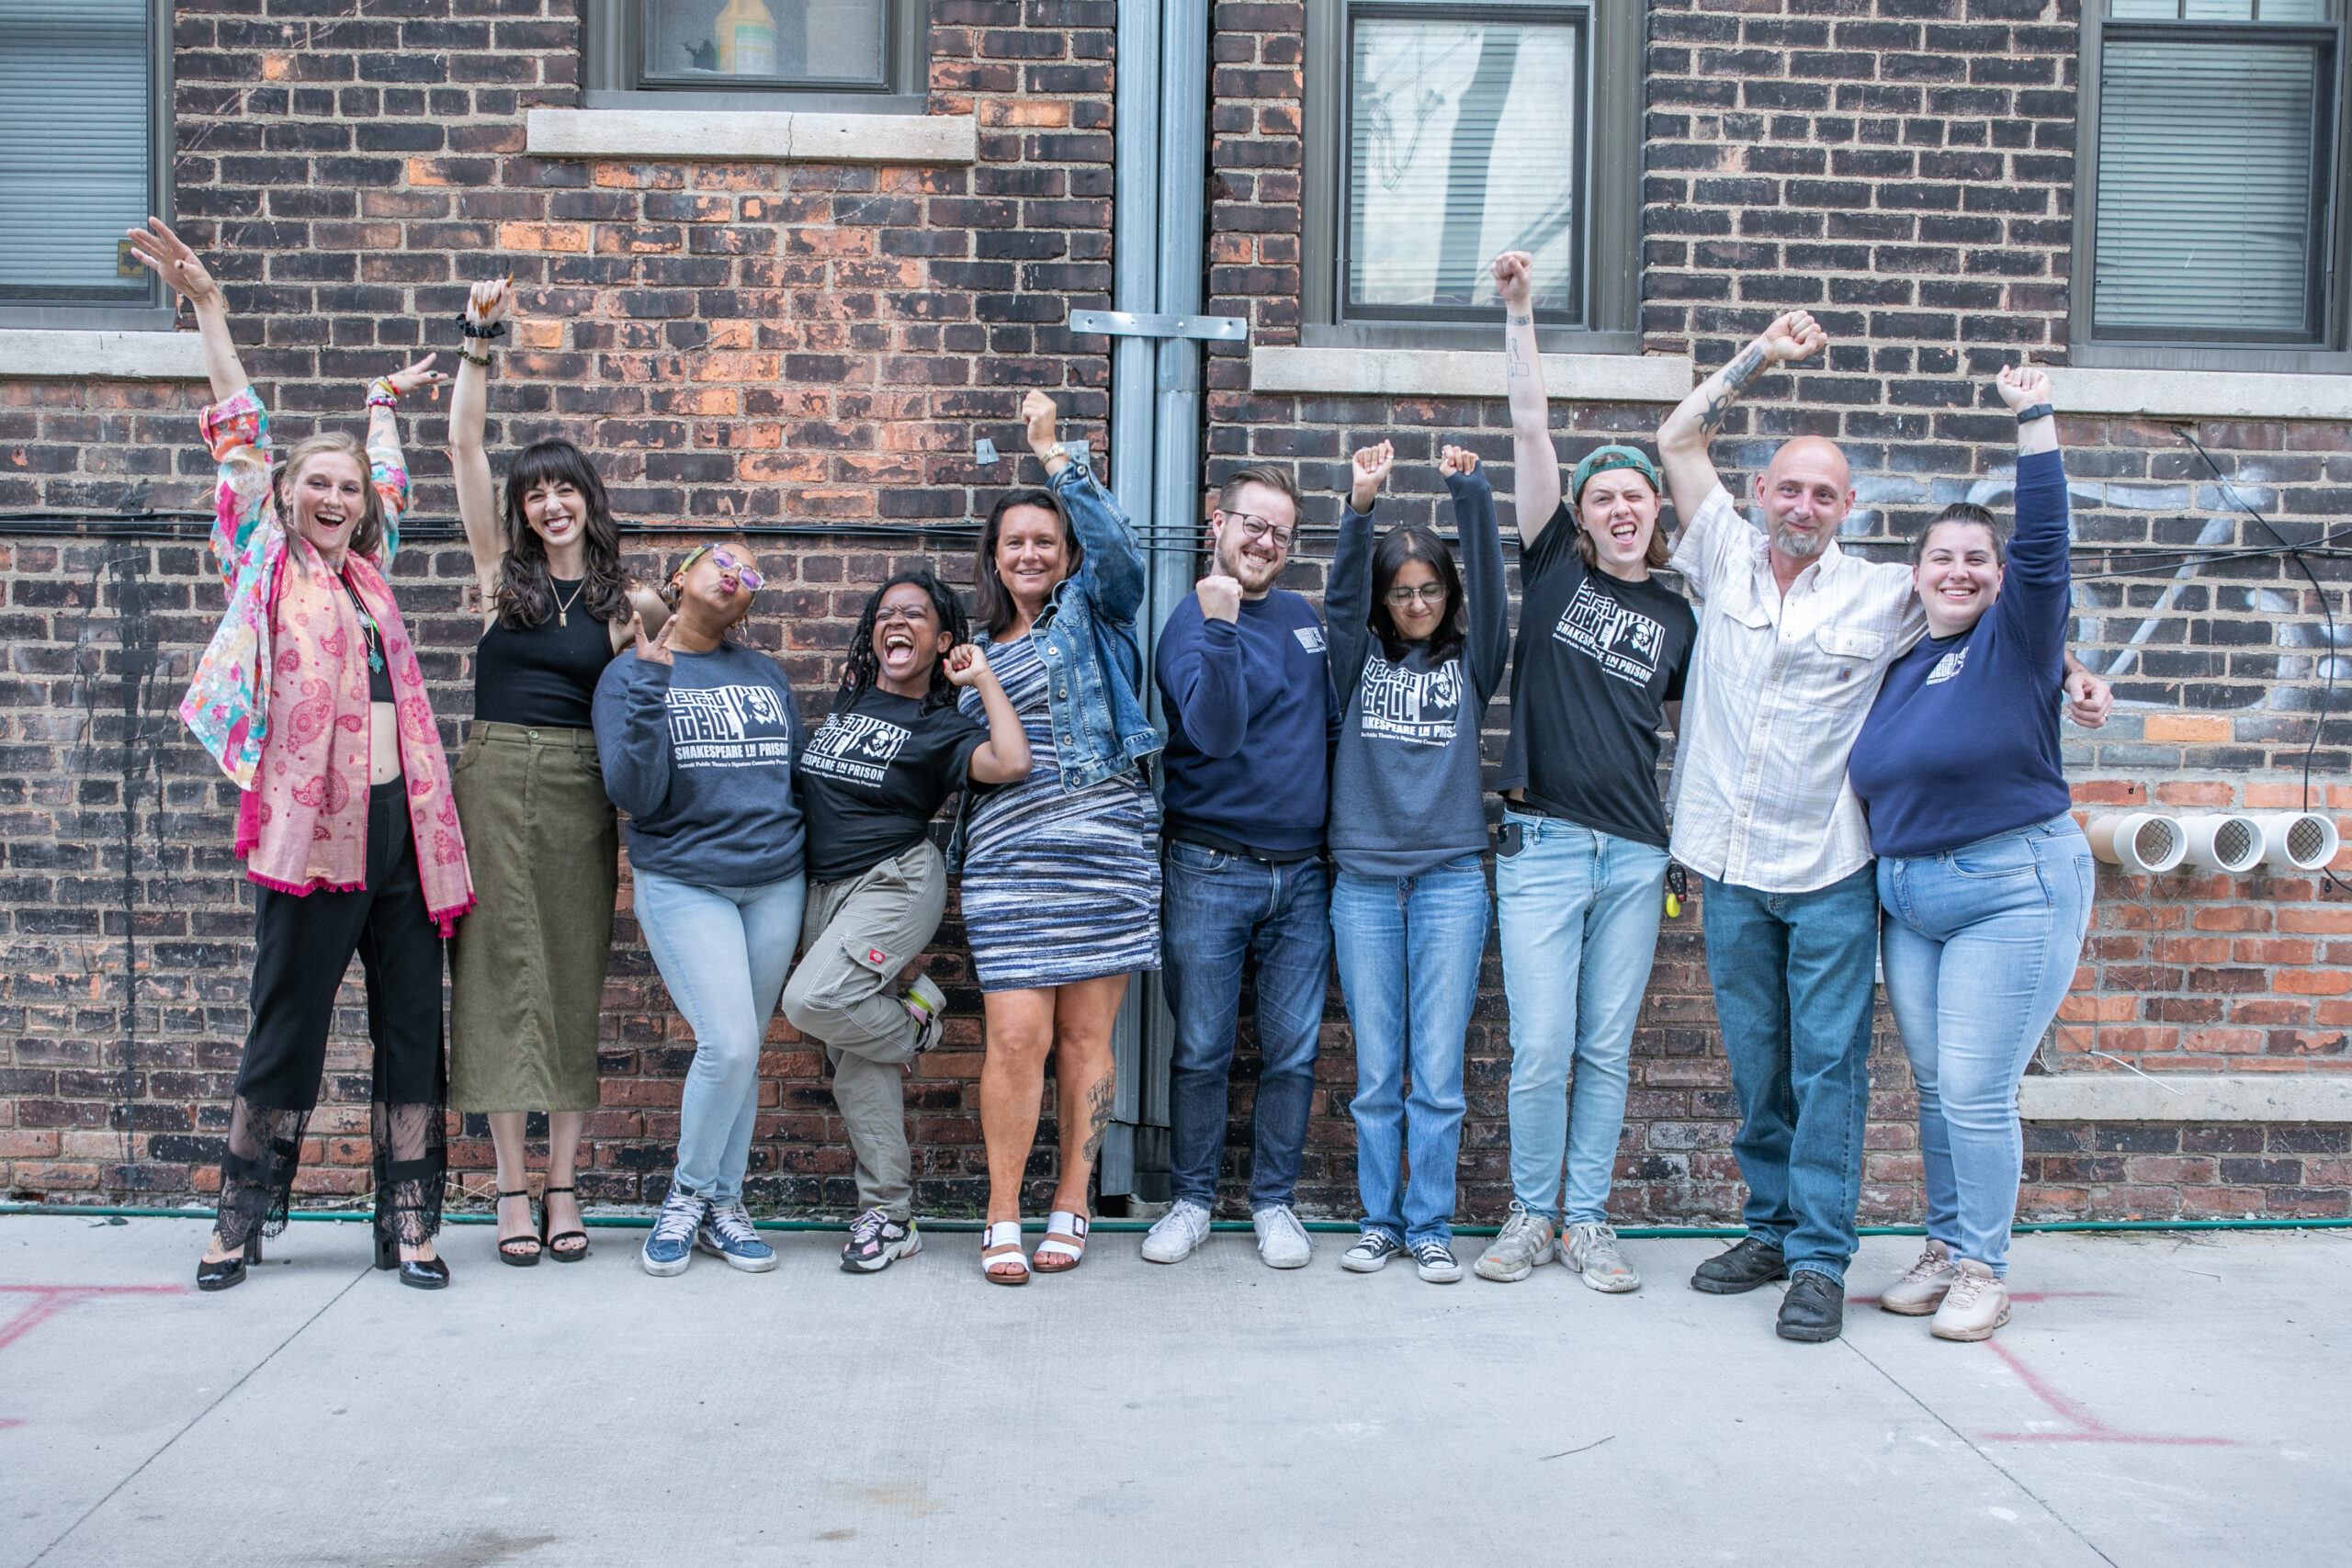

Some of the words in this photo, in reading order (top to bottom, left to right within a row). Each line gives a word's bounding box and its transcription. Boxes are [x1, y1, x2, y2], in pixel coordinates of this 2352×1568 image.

[1604, 653, 1620, 669] IN
[1617, 658, 1653, 683] PRISON
[1418, 725, 1430, 738] IN
[675, 745, 743, 761] SHAKESPEARE
[744, 743, 756, 758] IN
[759, 741, 788, 757] PRISON
[835, 761, 848, 774] IN
[847, 762, 885, 783] PRISON
